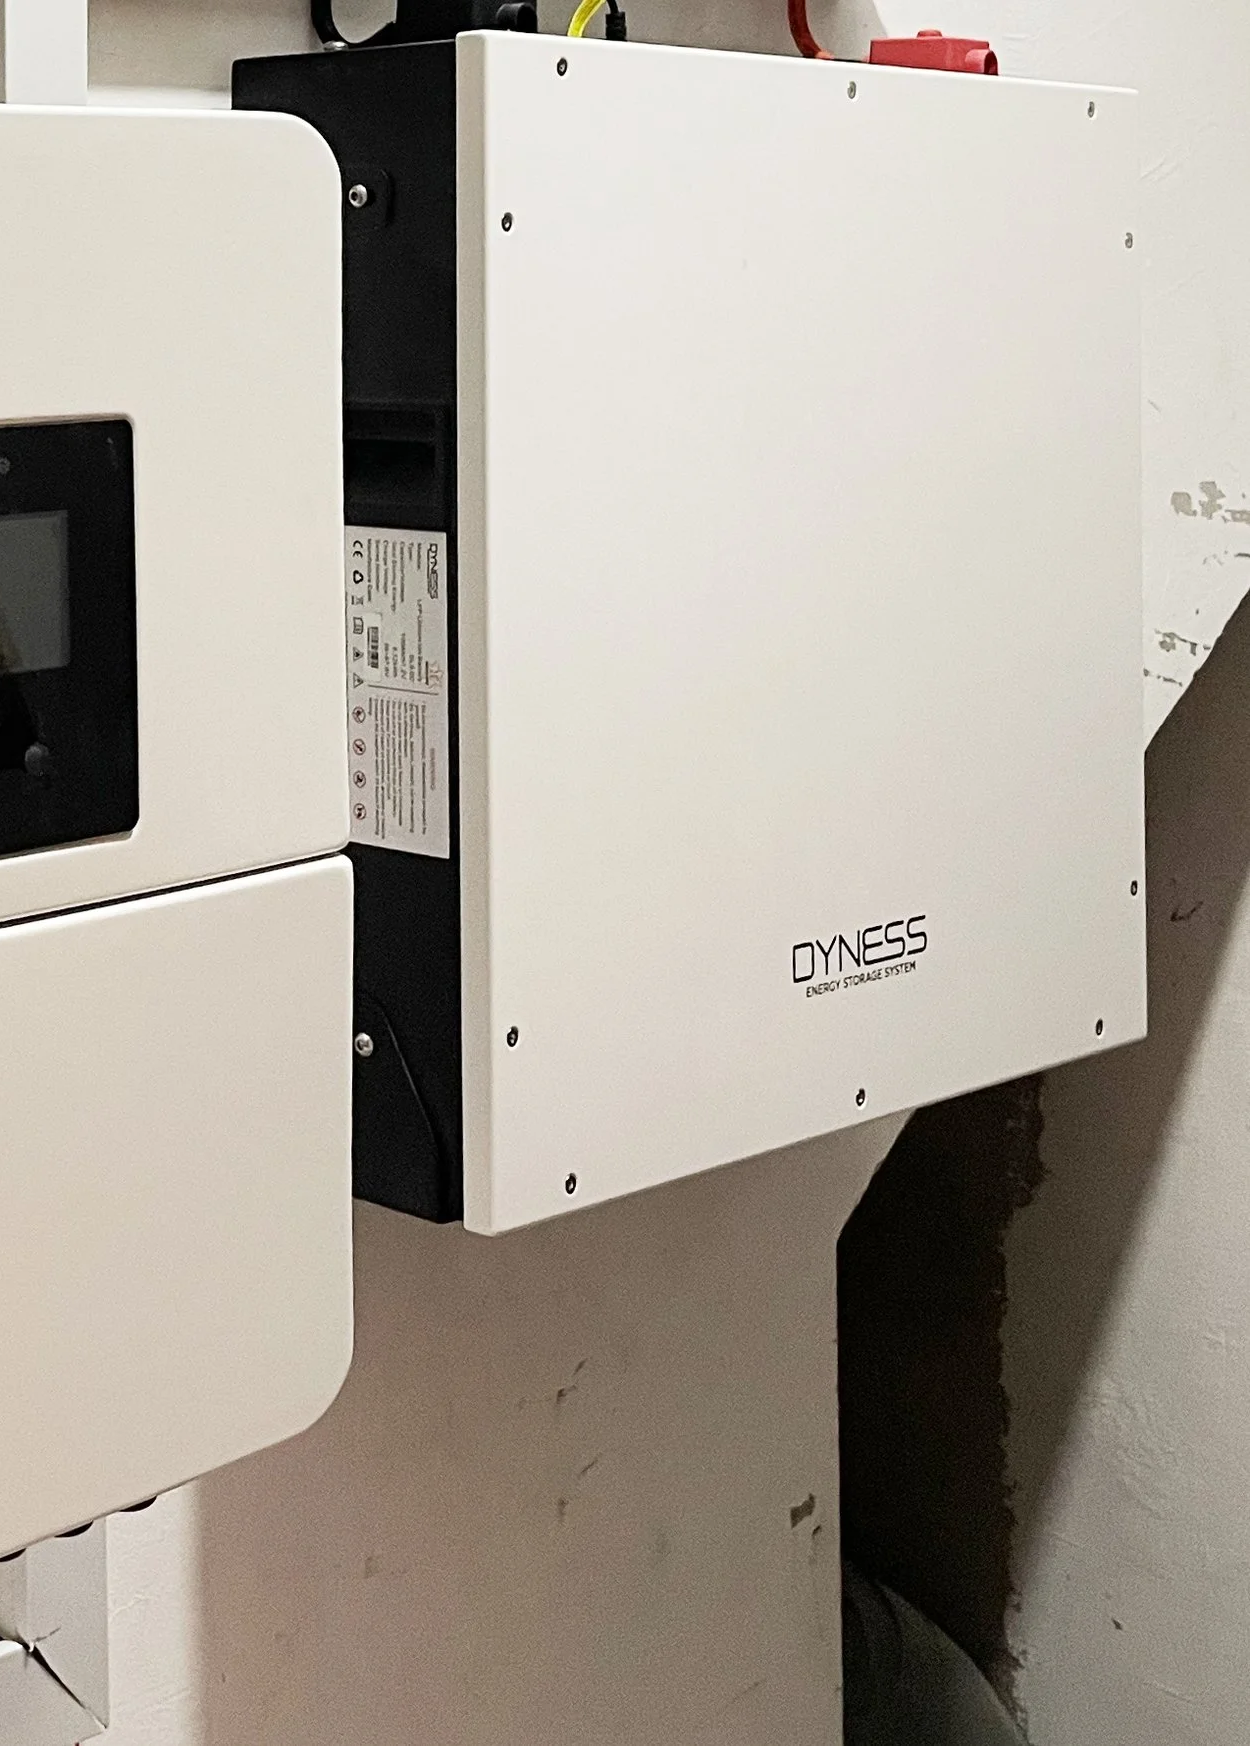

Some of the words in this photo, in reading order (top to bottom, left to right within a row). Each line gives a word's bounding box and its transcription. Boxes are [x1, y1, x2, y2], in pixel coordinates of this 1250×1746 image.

[793, 915, 927, 983] DYNESS
[806, 980, 841, 998] ENERGY
[843, 968, 882, 989] STORAGE
[884, 960, 916, 978] SYSTEM
